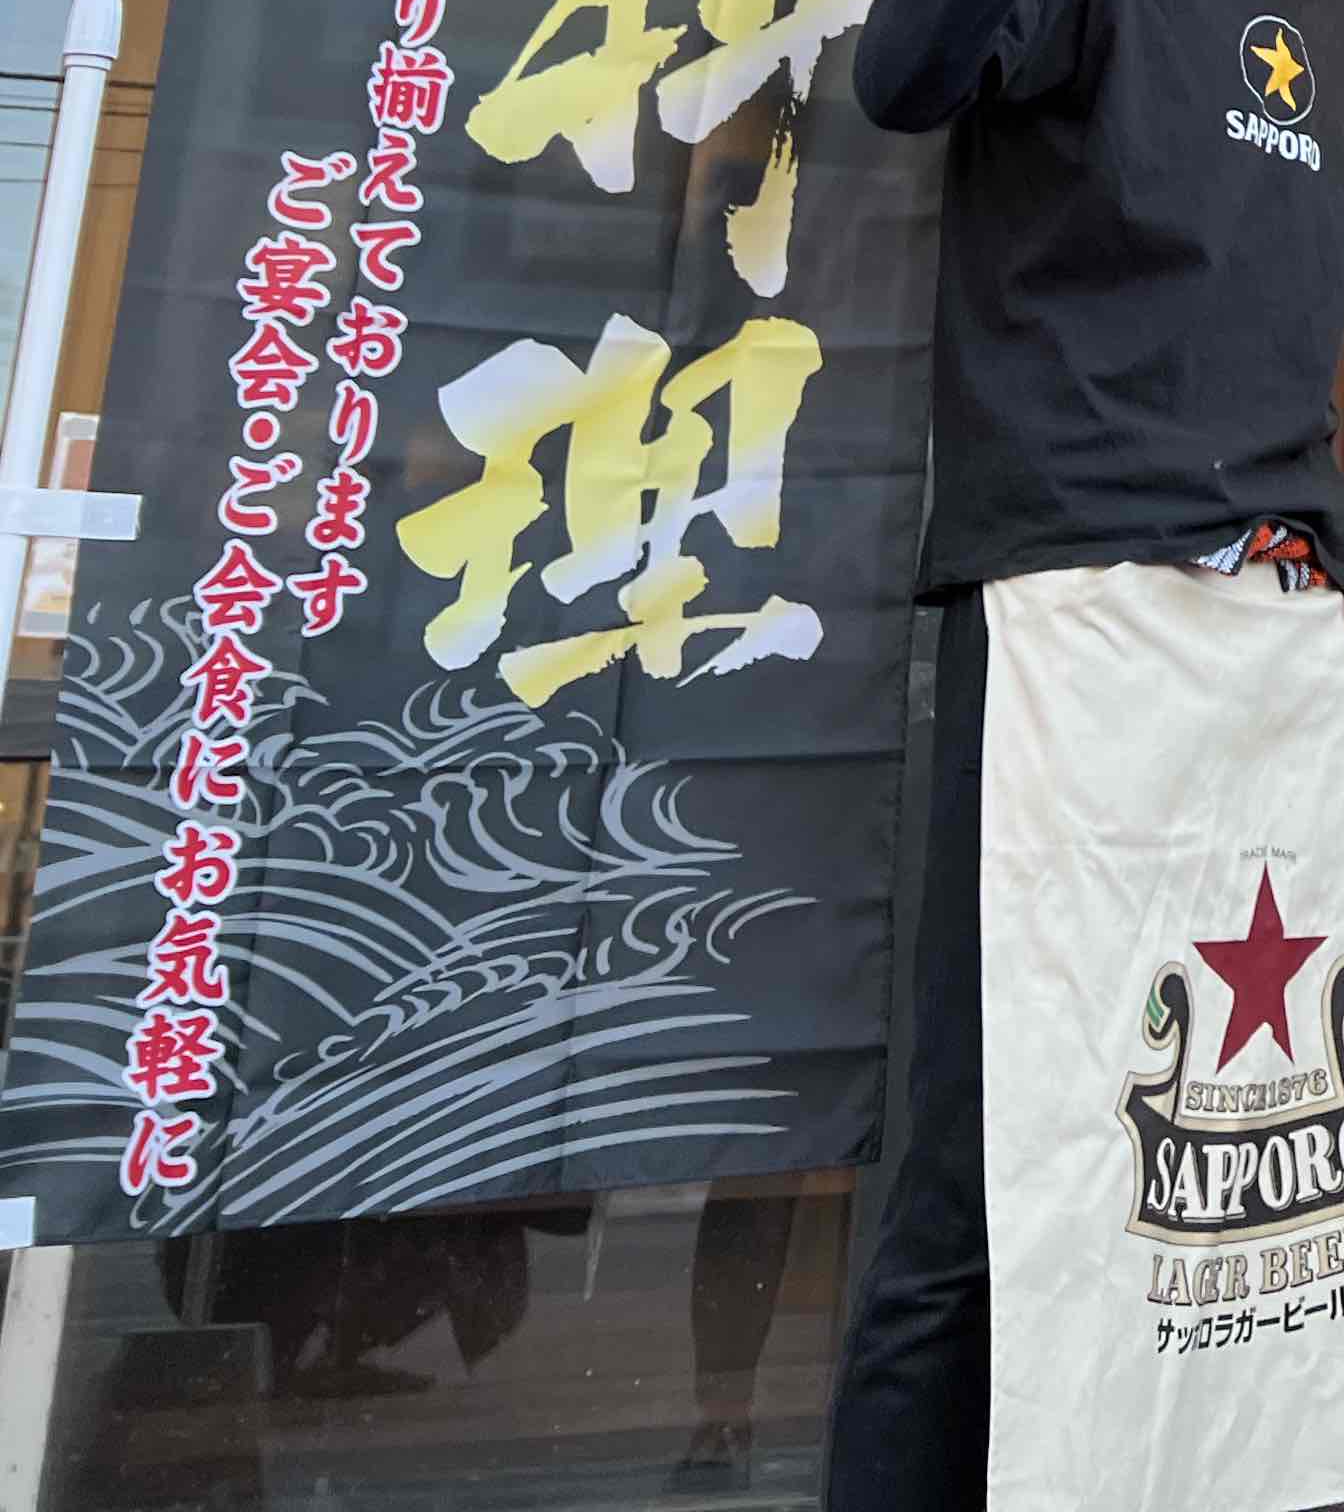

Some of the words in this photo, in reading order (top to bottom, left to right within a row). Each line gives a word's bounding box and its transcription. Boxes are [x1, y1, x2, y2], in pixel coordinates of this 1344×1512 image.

[1225, 109, 1321, 172] SAPPORO
[119, 150, 356, 1194] ご宴会・ご会食にお気軽に
[1266, 1068, 1329, 1108] 1876
